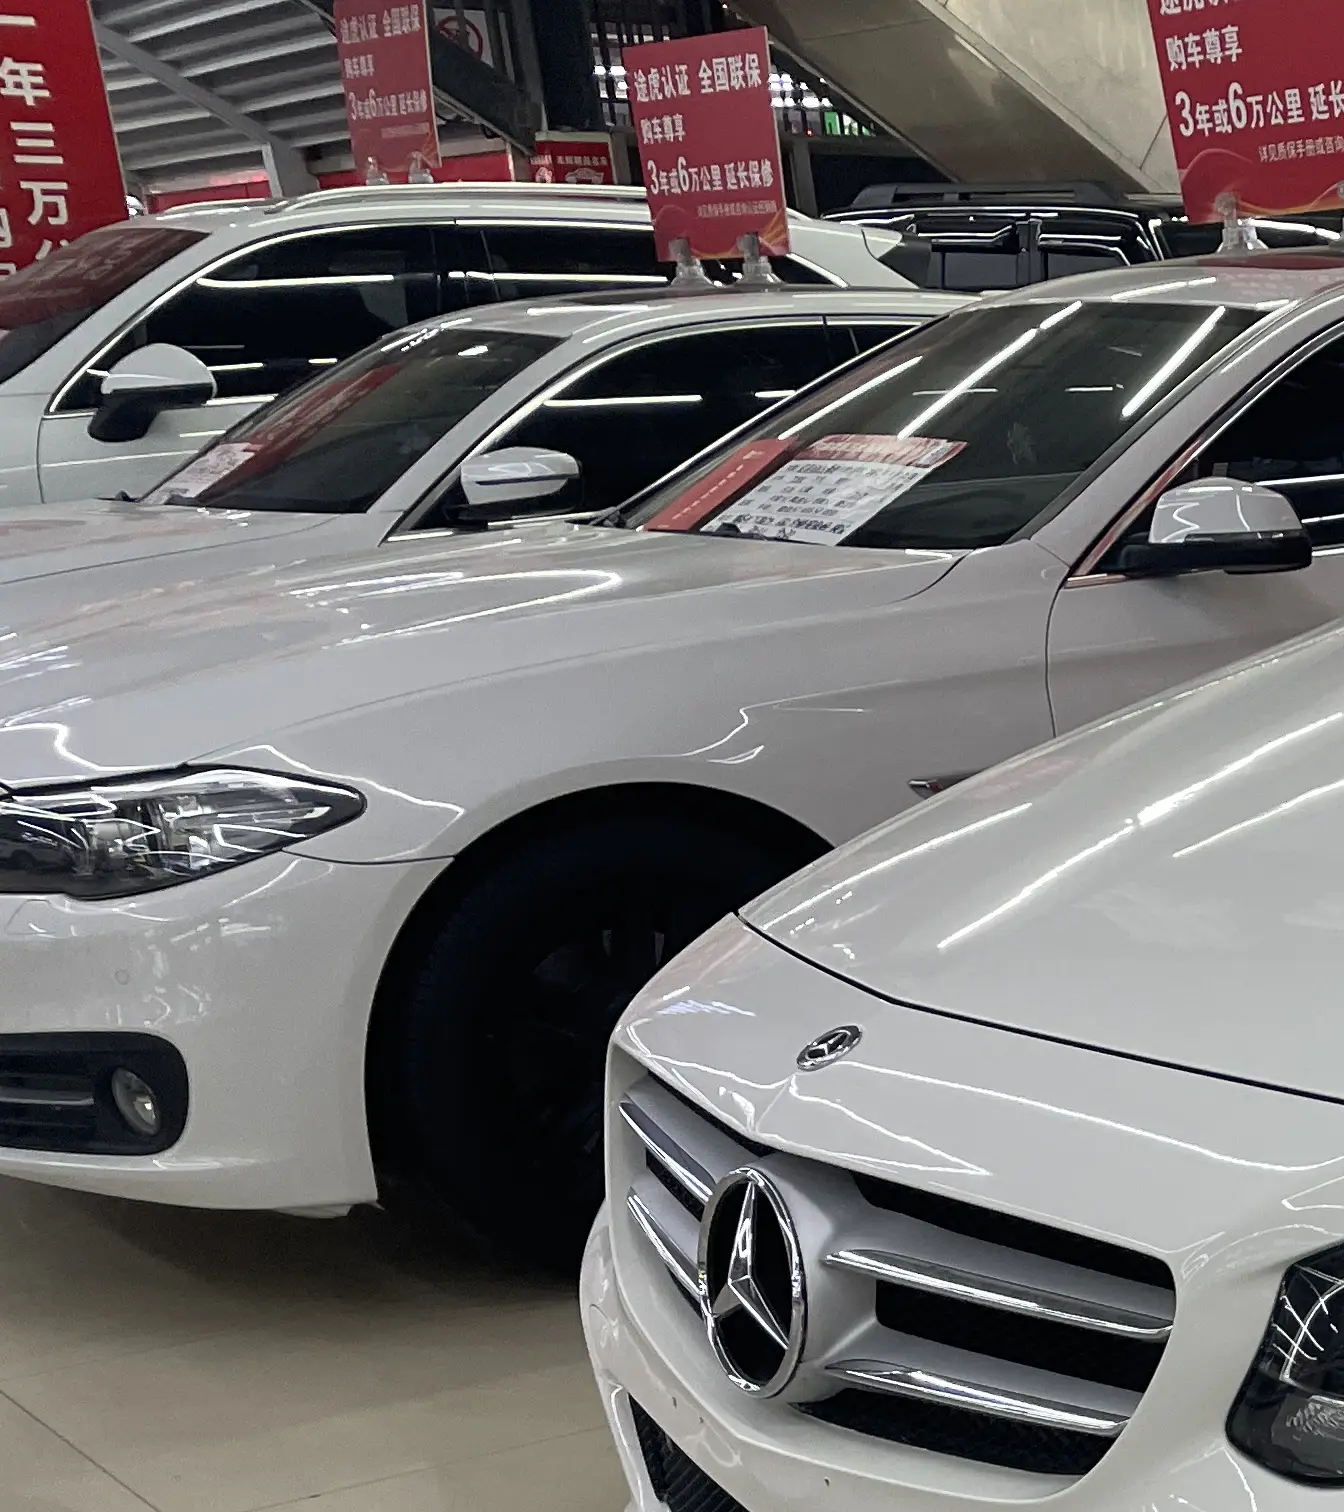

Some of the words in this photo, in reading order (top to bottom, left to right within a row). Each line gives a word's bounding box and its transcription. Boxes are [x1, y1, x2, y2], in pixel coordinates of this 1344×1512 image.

[1165, 24, 1243, 71] 购车尊享
[634, 64, 691, 102] 途虎认证
[698, 53, 762, 93] 全国联保
[640, 113, 686, 144] 购车尊享
[1175, 82, 1305, 137] 3年或6万公里
[647, 156, 724, 195] 3年或6万公里
[724, 158, 774, 190] 延长保修
